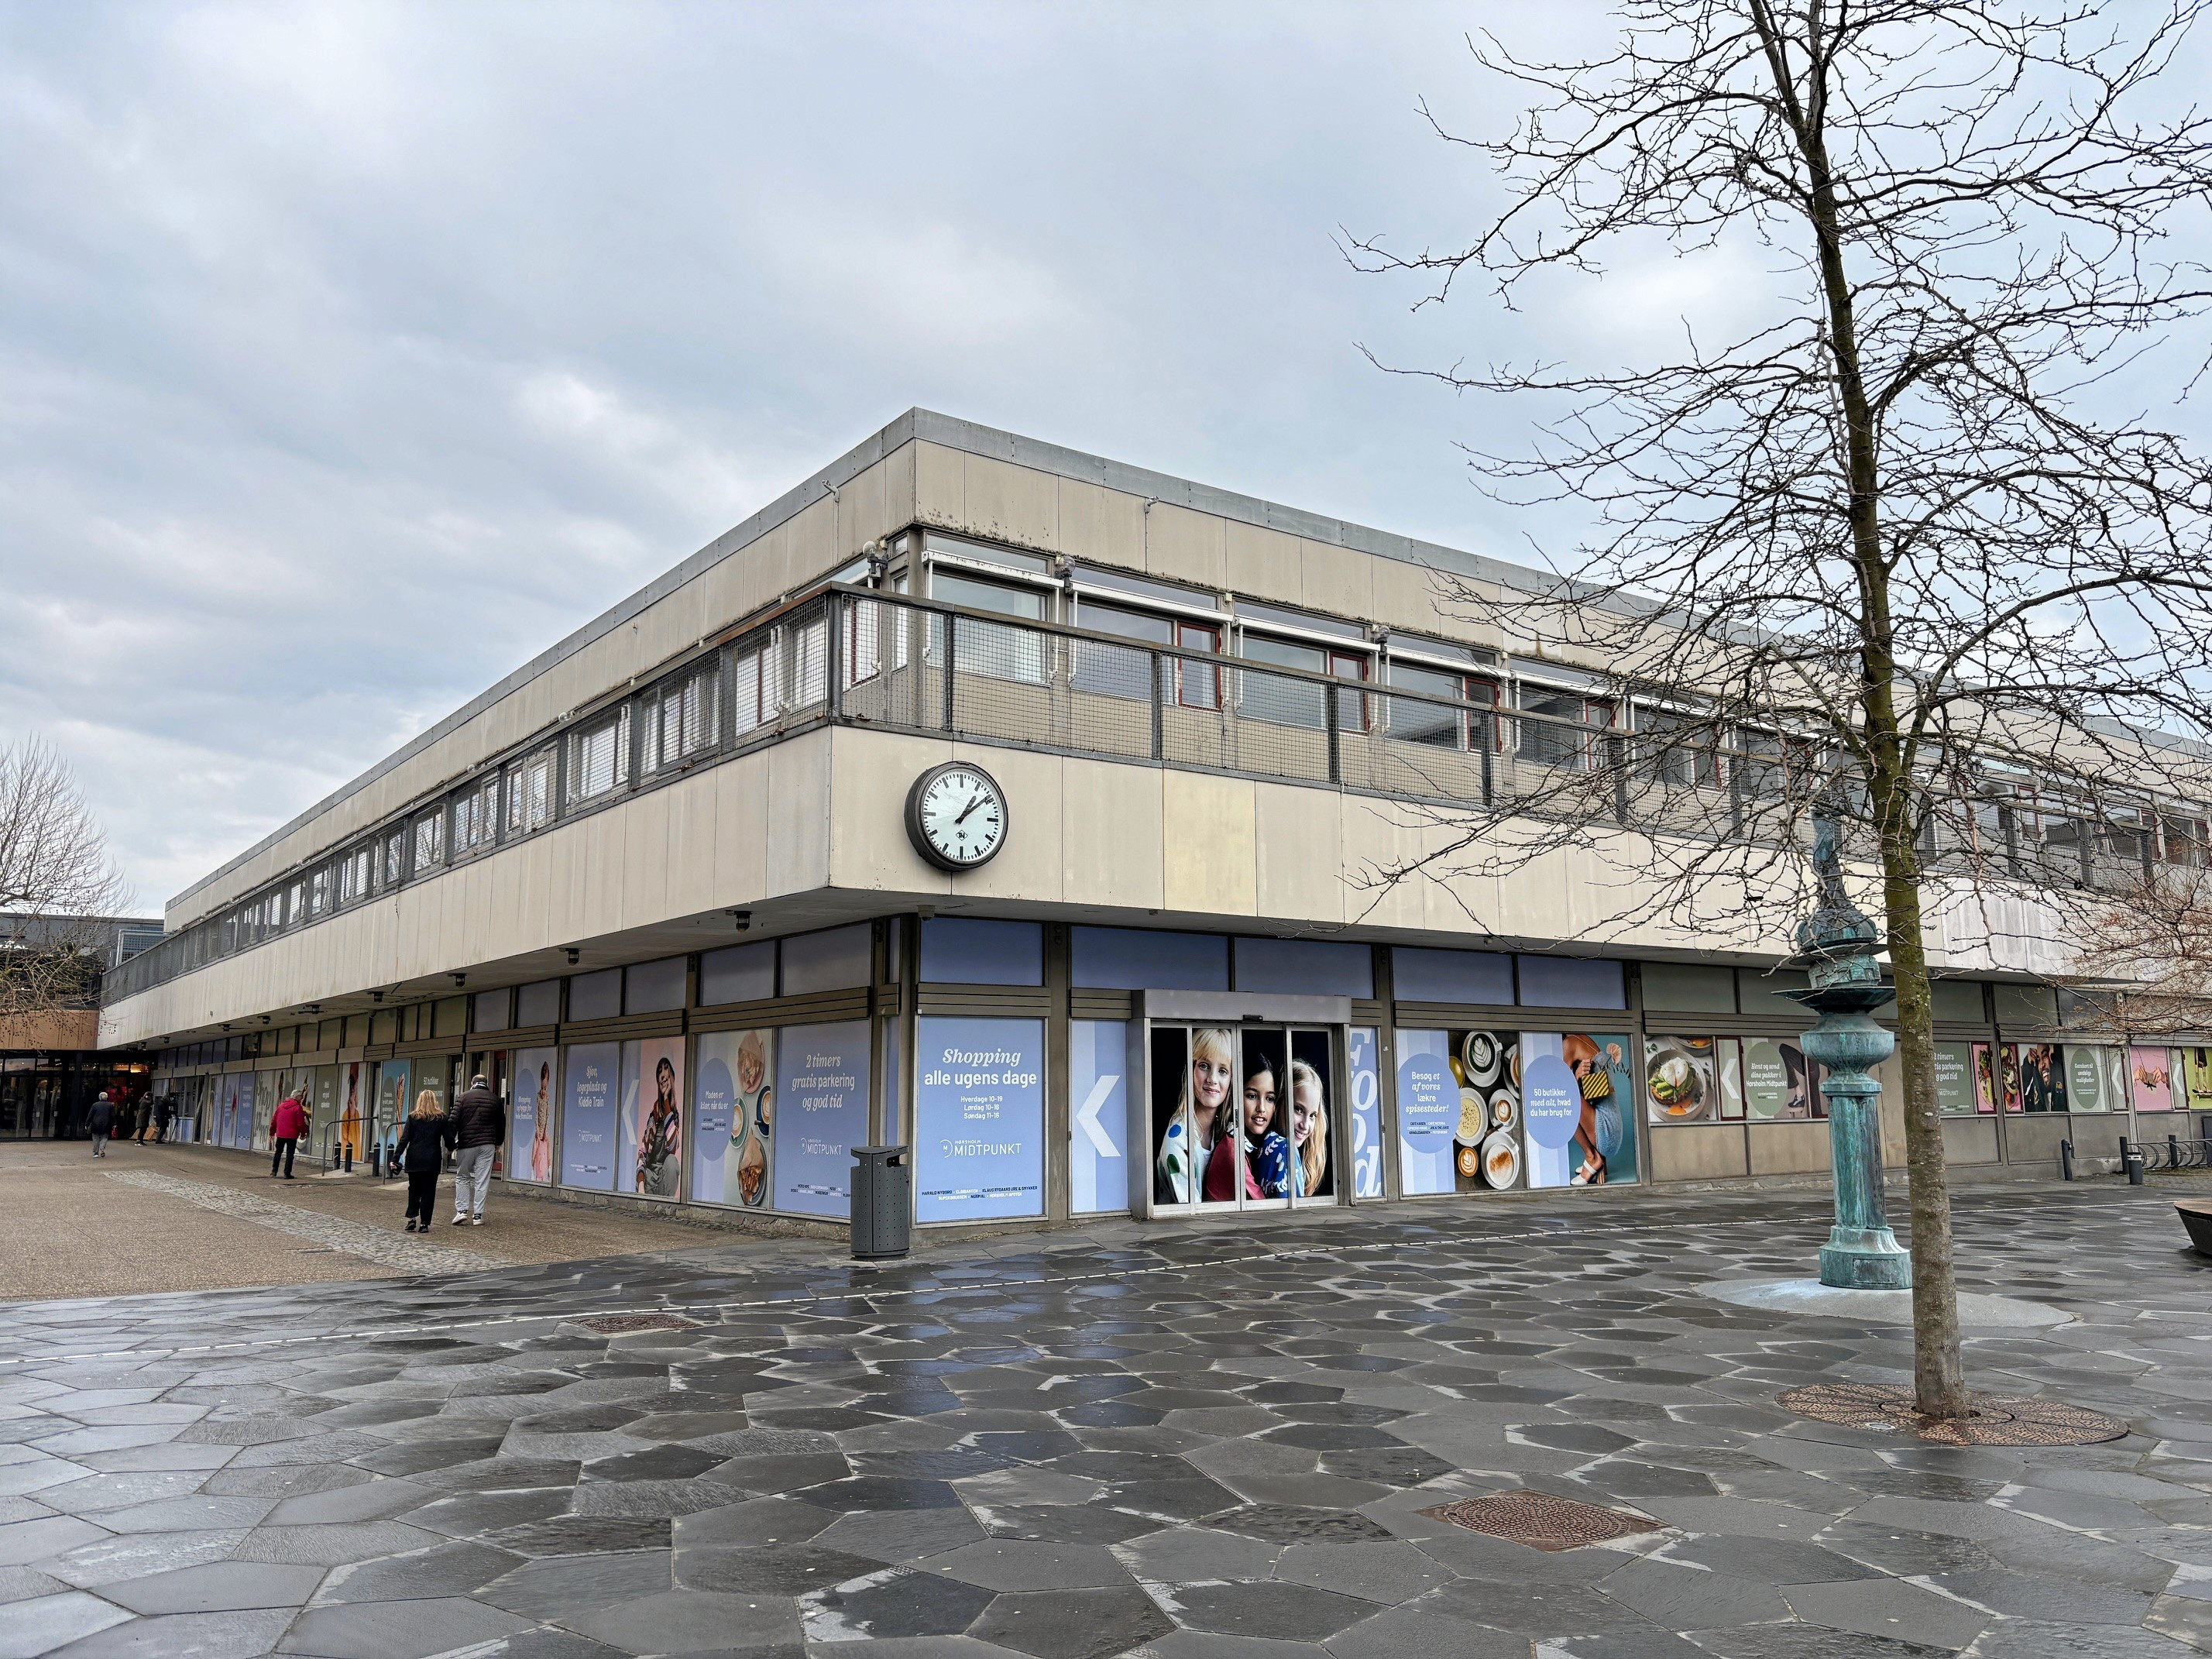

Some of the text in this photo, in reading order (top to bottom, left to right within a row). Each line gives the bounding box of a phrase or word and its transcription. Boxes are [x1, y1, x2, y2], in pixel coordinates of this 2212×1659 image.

[805, 1053, 841, 1068] 2 timers
[943, 1048, 1021, 1067] Shopping
[1937, 1052, 1954, 1060] timers
[1941, 1062, 1963, 1072] parkering
[925, 1070, 1037, 1089] alle ugens dage
[1411, 1071, 1432, 1082] Besøg
[1762, 1071, 1778, 1080] pakker
[1939, 1072, 1949, 1082] god
[1949, 1072, 1958, 1080] tid
[577, 1081, 607, 1094] legeplads og
[792, 1073, 855, 1091] gratis parkering
[1412, 1082, 1422, 1092] af
[1766, 1080, 1788, 1088] Midtpunkt
[705, 1091, 718, 1099] Maden
[1417, 1093, 1436, 1102] lækre
[1534, 1088, 1566, 1097] 50 butikker
[578, 1096, 604, 1108] Kiddie Train
[802, 1093, 843, 1111] og god tid
[1530, 1097, 1571, 1108] med alt, hvad
[1405, 1104, 1449, 1115] spisesteder!
[1530, 1108, 1572, 1118] du har brug for
[807, 1143, 843, 1156] MIDTPUNKT
[954, 1142, 1022, 1156] MIDTPUNKT
